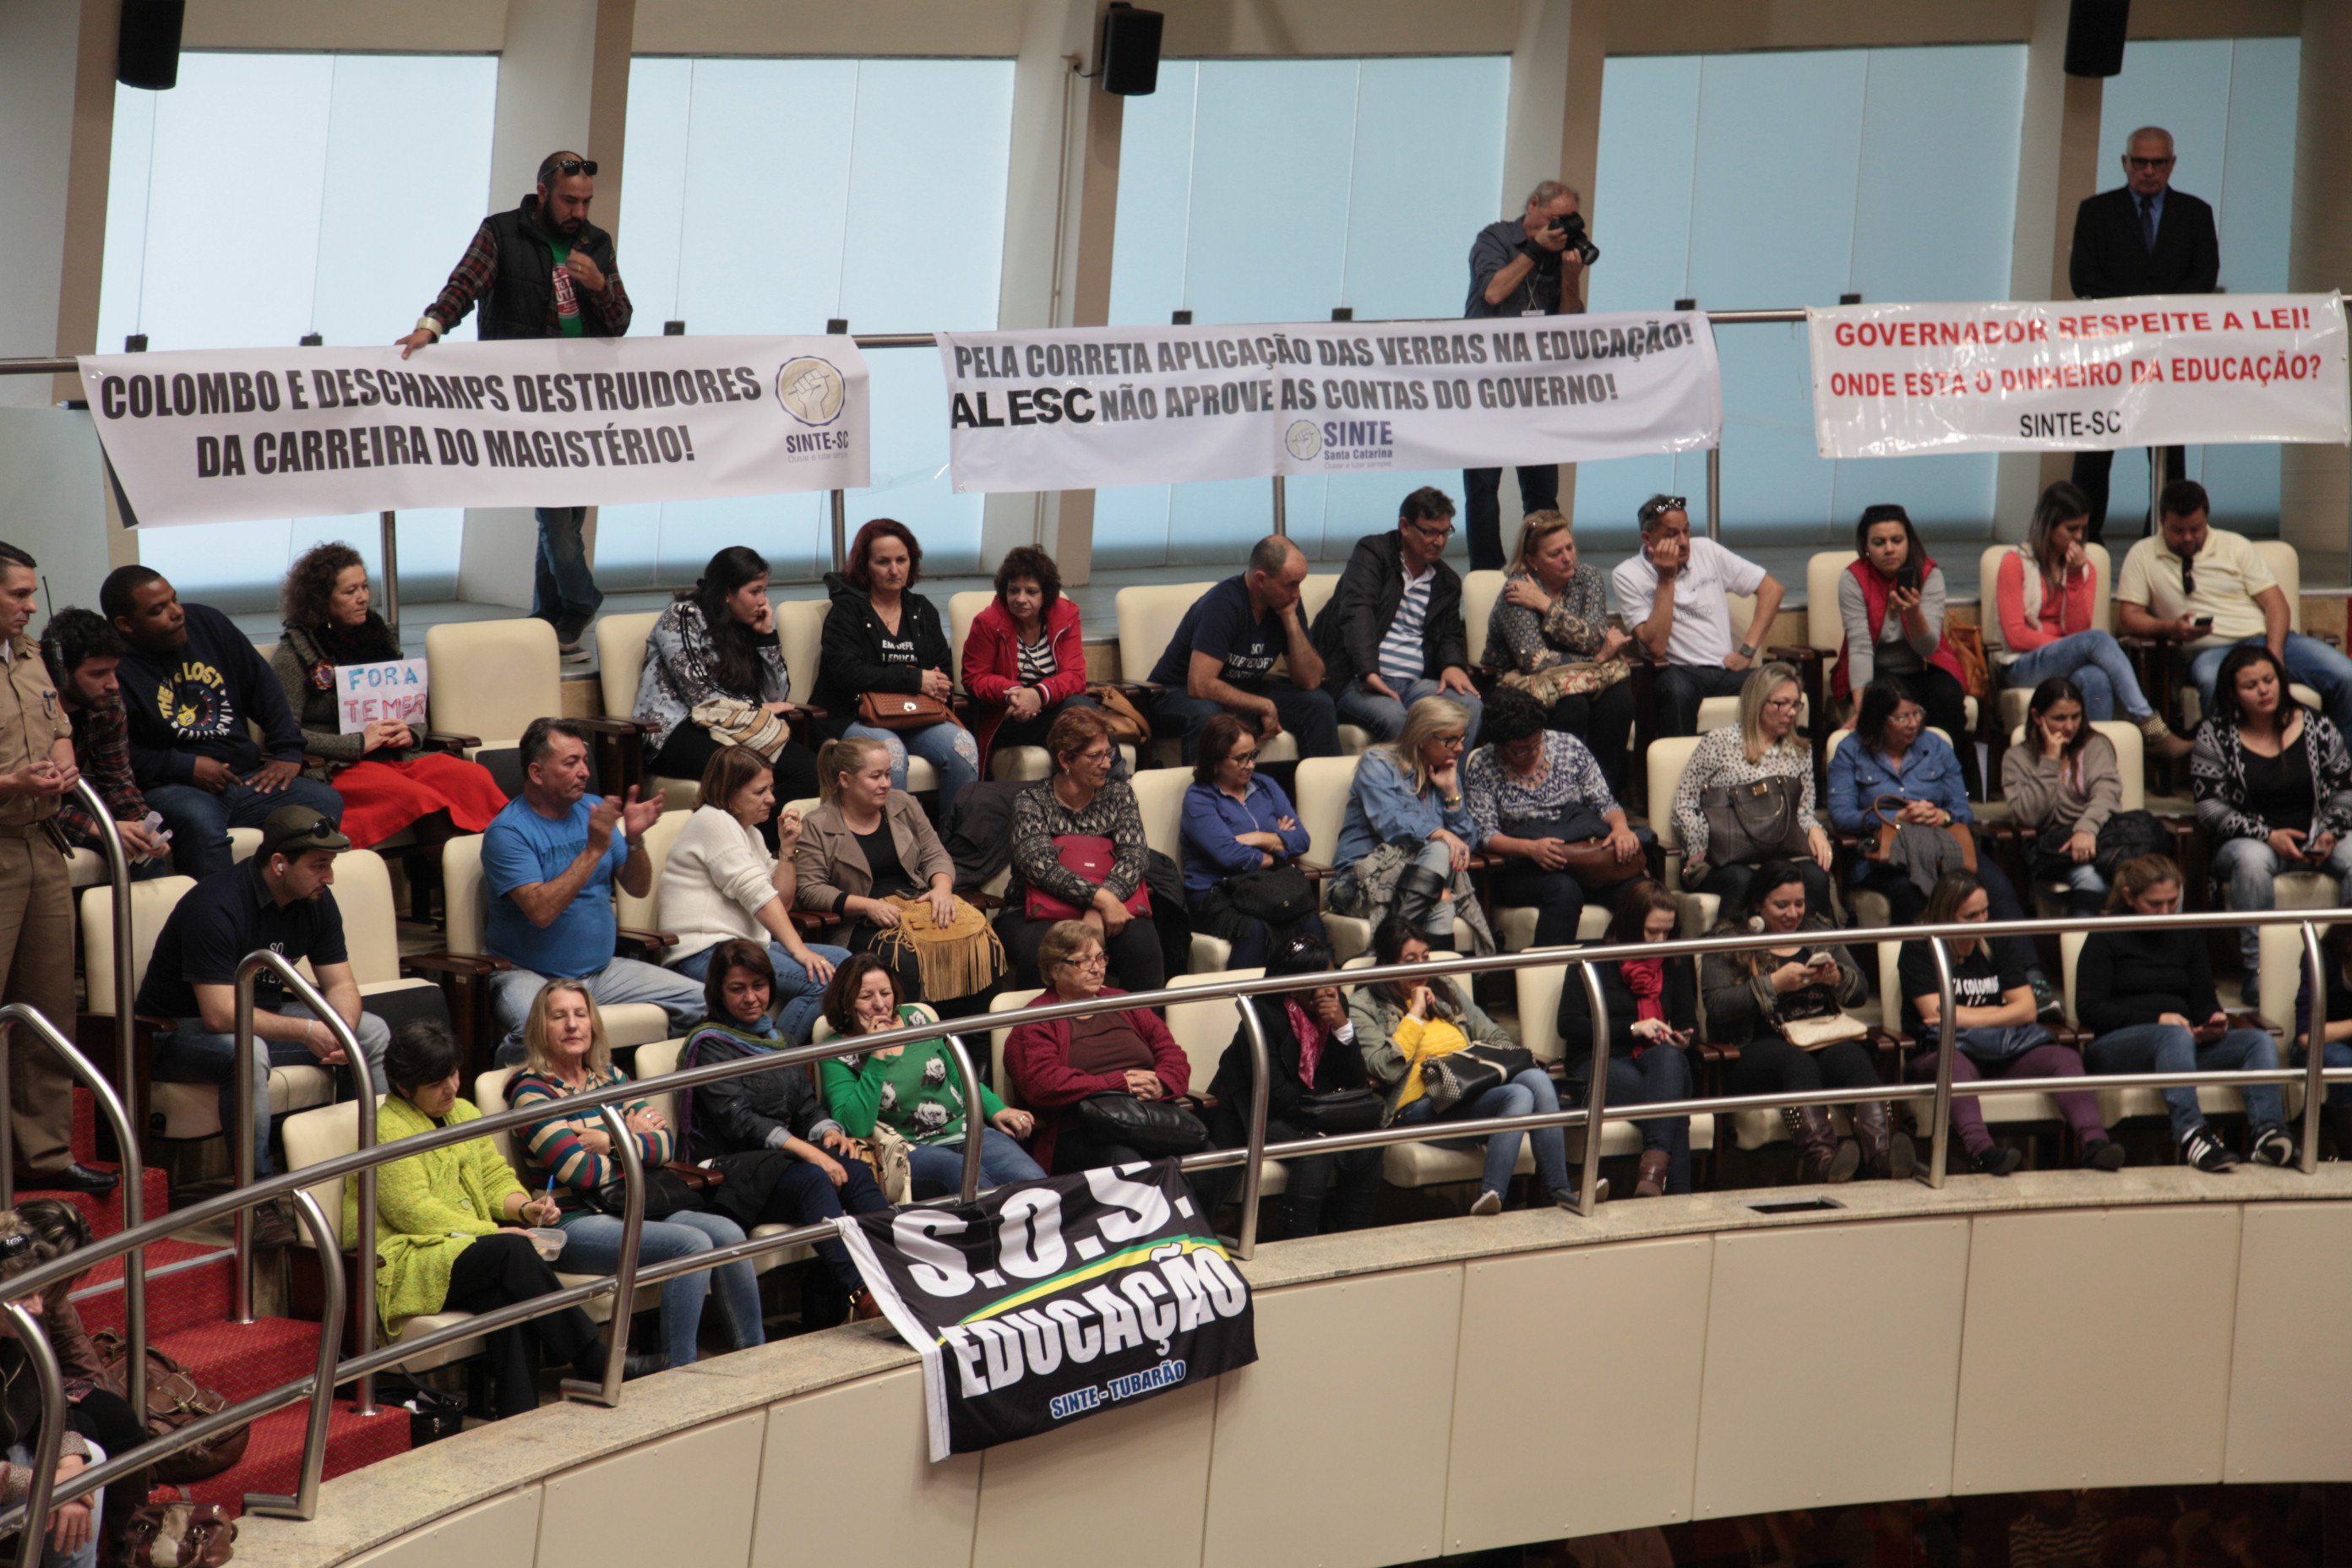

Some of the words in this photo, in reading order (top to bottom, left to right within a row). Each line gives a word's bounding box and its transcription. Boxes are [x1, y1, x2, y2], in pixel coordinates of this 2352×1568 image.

[954, 345, 1021, 378] PELA
[1026, 342, 1152, 377] CORRETA
[1157, 333, 1312, 372] APLICAÇÃO
[1318, 337, 1375, 367] DAS
[1376, 333, 1488, 366] VERBAS
[1492, 331, 1533, 363] NA
[1538, 319, 1695, 363] EDUCAÇÃO!
[1834, 318, 2049, 347] GOVERNADOR
[2059, 312, 2212, 340] RESPEITE
[2223, 312, 2243, 330] A
[2252, 308, 2311, 329] LEI!
[101, 369, 280, 420] COLOMBO
[286, 370, 309, 411] E
[312, 368, 510, 412] DESCHAMPS
[513, 366, 762, 413] DESTRUIDORES
[1831, 373, 1897, 397] ONDE
[1974, 370, 1993, 393] O
[2001, 362, 2122, 392] DINHEIRO
[2131, 357, 2164, 385] DA
[2171, 350, 2322, 388] EDUCAÇÃO?
[951, 387, 1096, 429] ALESC
[1098, 382, 1158, 422] NÃO
[1165, 380, 1274, 418] APROVE
[1280, 378, 1317, 411] AS
[1322, 378, 1429, 411] CONTAS
[1432, 378, 1473, 411] DO
[1477, 373, 1619, 411] GOVERNO!
[786, 430, 849, 454] SINTE-SC
[1323, 421, 1393, 448] SINTE
[2020, 410, 2122, 438] SINTE-SC
[196, 434, 246, 478] DA
[253, 425, 433, 476] CARREIRA
[433, 427, 480, 467] DO
[482, 422, 695, 468] MAGISTÉRIO!
[1324, 449, 1350, 461] Santa
[1353, 448, 1393, 460] Catarina
[182, 662, 225, 689] LOST
[348, 667, 418, 690] FORA
[343, 694, 427, 723] TEMER
[891, 1161, 1196, 1298] S.O.S.
[937, 1241, 1248, 1399] EDUCAÇÃO
[1050, 1385, 1100, 1419] SINTE
[1107, 1359, 1187, 1402] TUBARÃO
